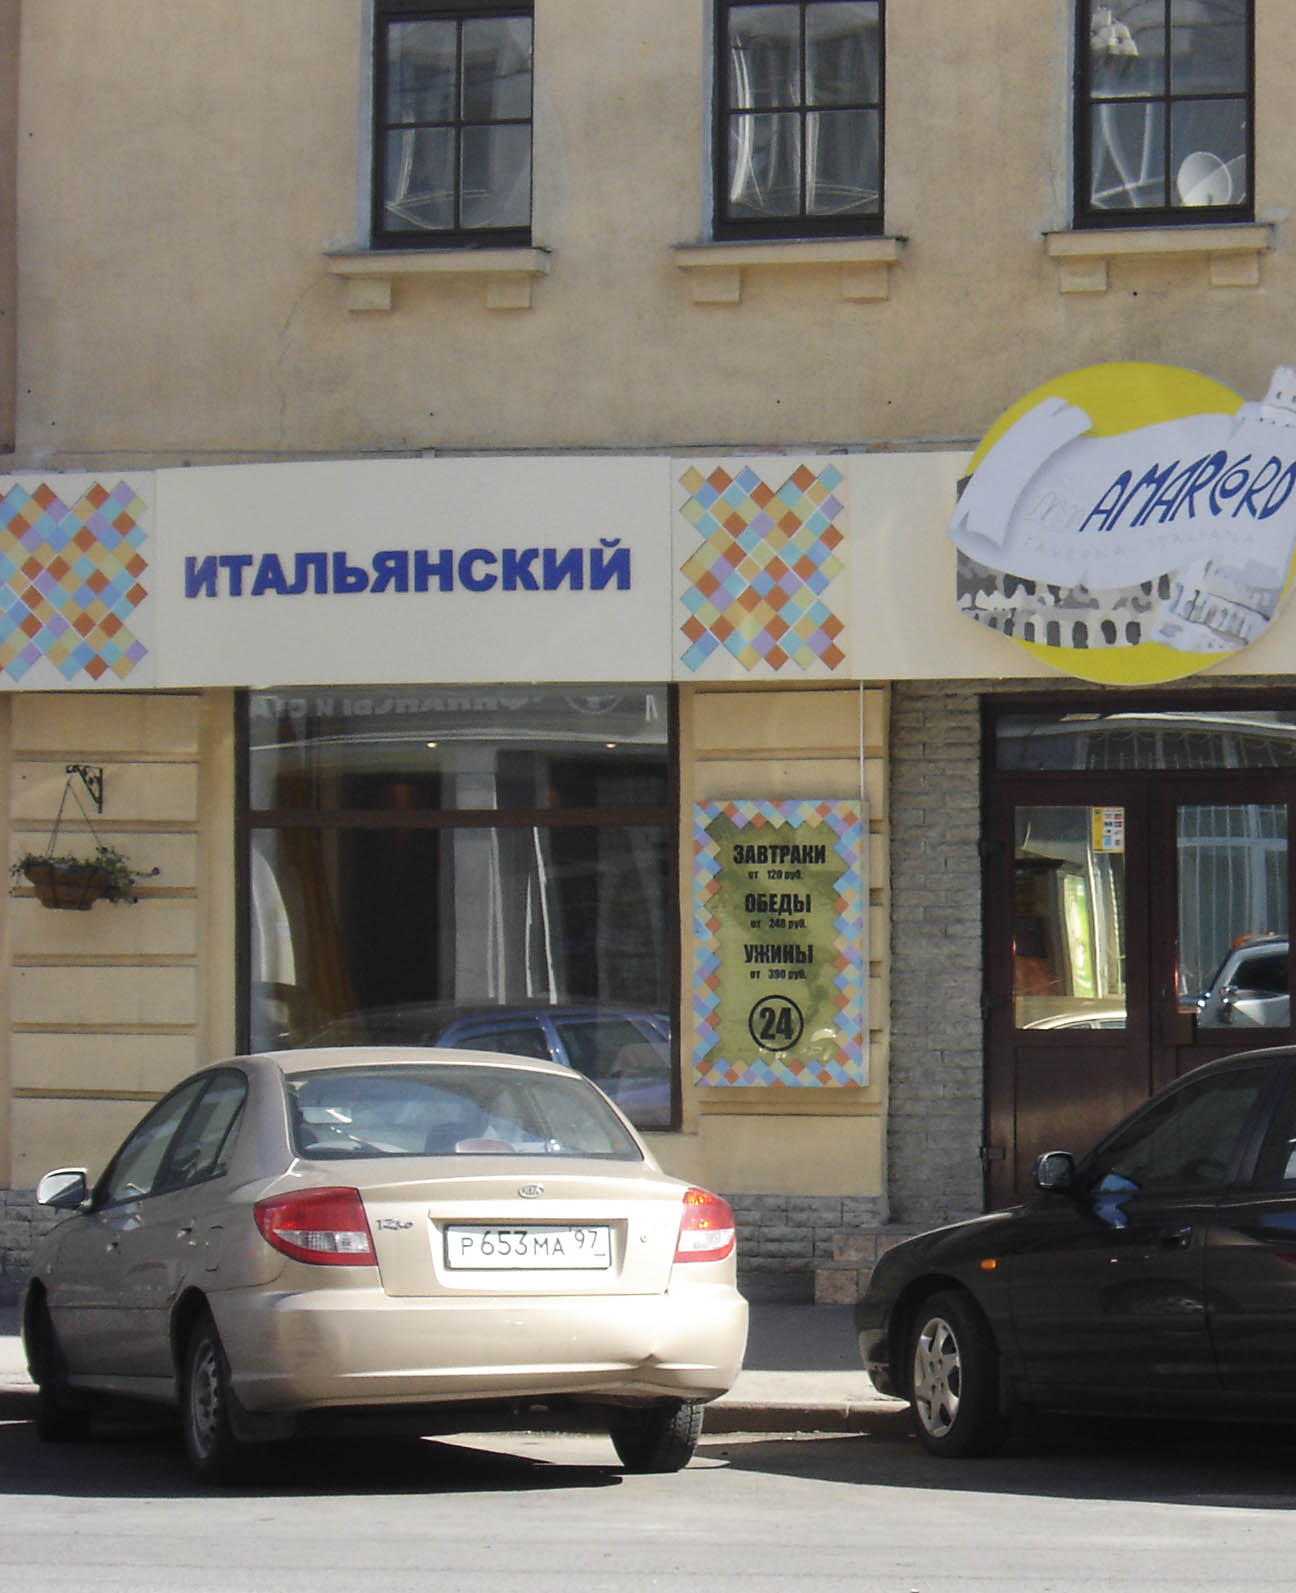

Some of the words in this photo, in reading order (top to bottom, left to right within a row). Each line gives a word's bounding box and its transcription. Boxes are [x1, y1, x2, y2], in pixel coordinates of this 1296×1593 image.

[184, 537, 632, 599] ИТАЛЬЯНСКИЙ
[733, 845, 826, 864] ЗАВТРАКИ
[744, 893, 812, 915] ОБЕДЫ
[744, 944, 814, 964] УЖИНЫ
[759, 1007, 793, 1040] 24
